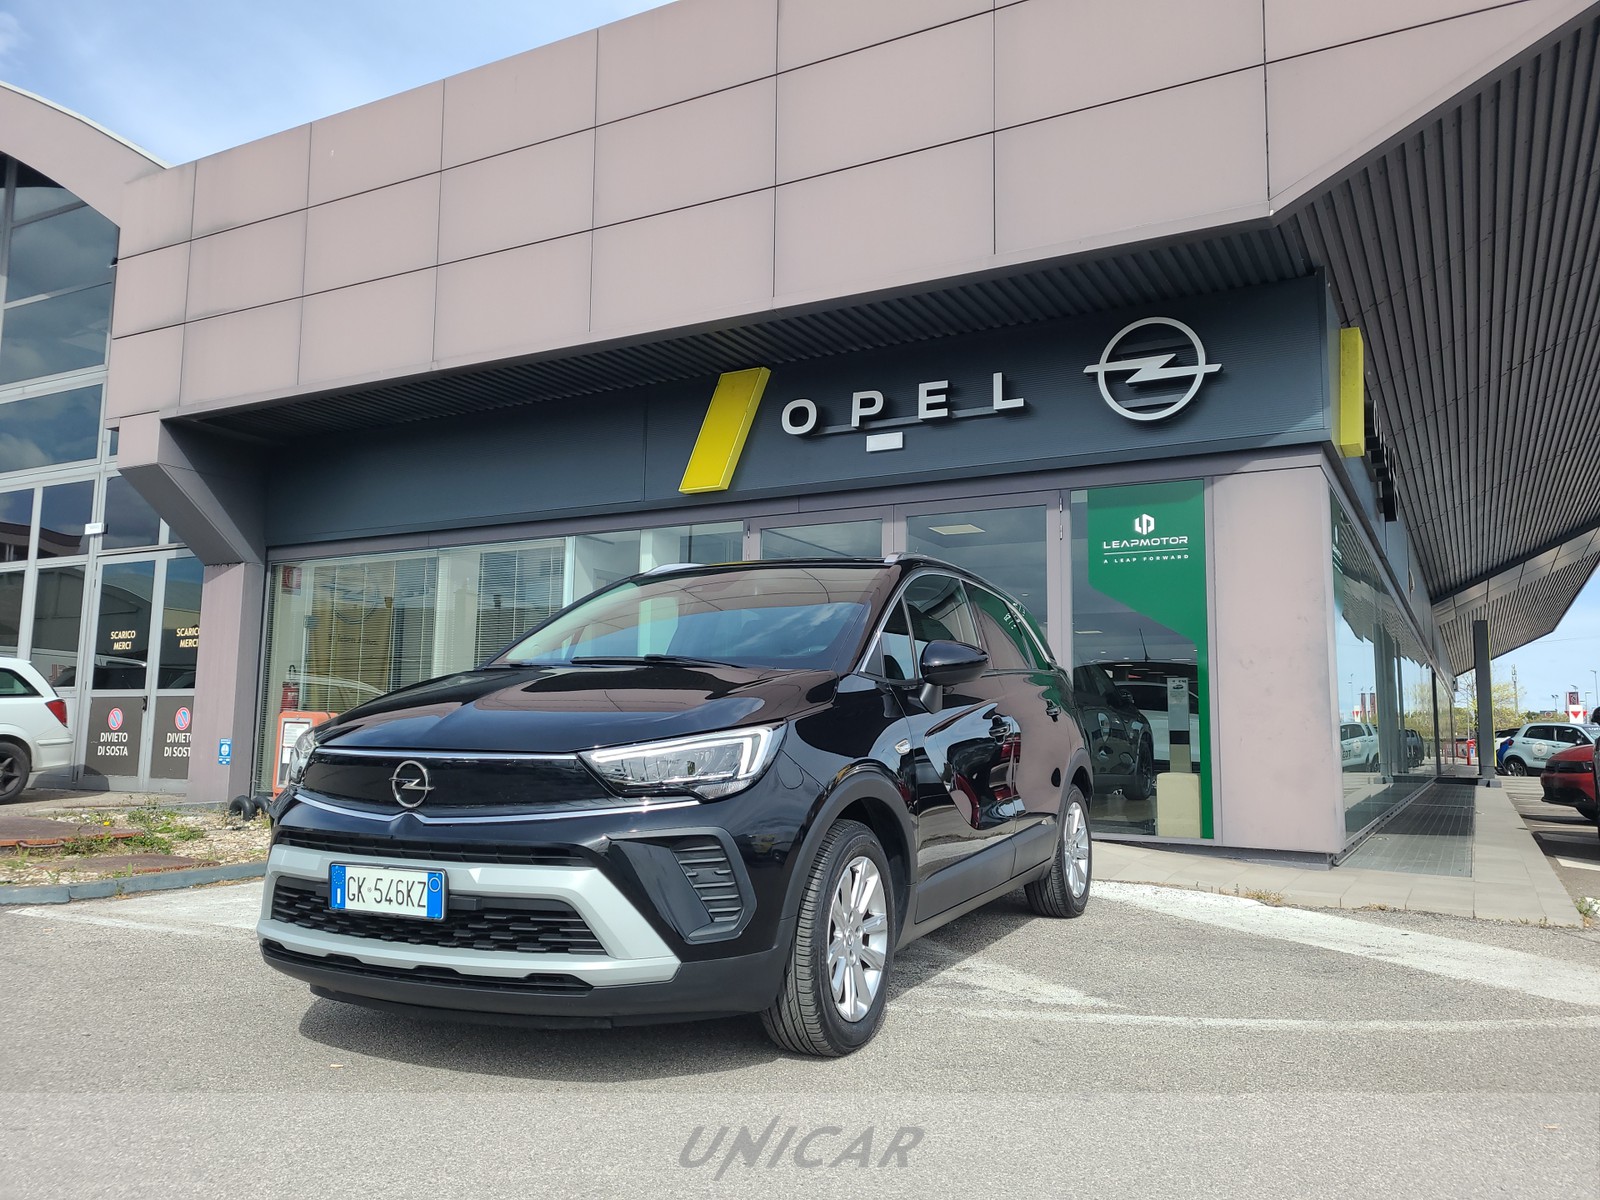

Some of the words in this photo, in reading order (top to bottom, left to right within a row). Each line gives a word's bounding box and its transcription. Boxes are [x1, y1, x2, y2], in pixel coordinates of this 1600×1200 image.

[781, 372, 1025, 436] OPEL
[1103, 536, 1188, 549] LEAPMOTOR
[110, 630, 136, 640] SCARICO
[113, 641, 132, 650] MERCI
[100, 732, 128, 743] DIVIETO
[97, 746, 107, 756] DI
[107, 746, 128, 756] SOSTA
[163, 746, 172, 757] DI
[172, 747, 191, 757] SOST
